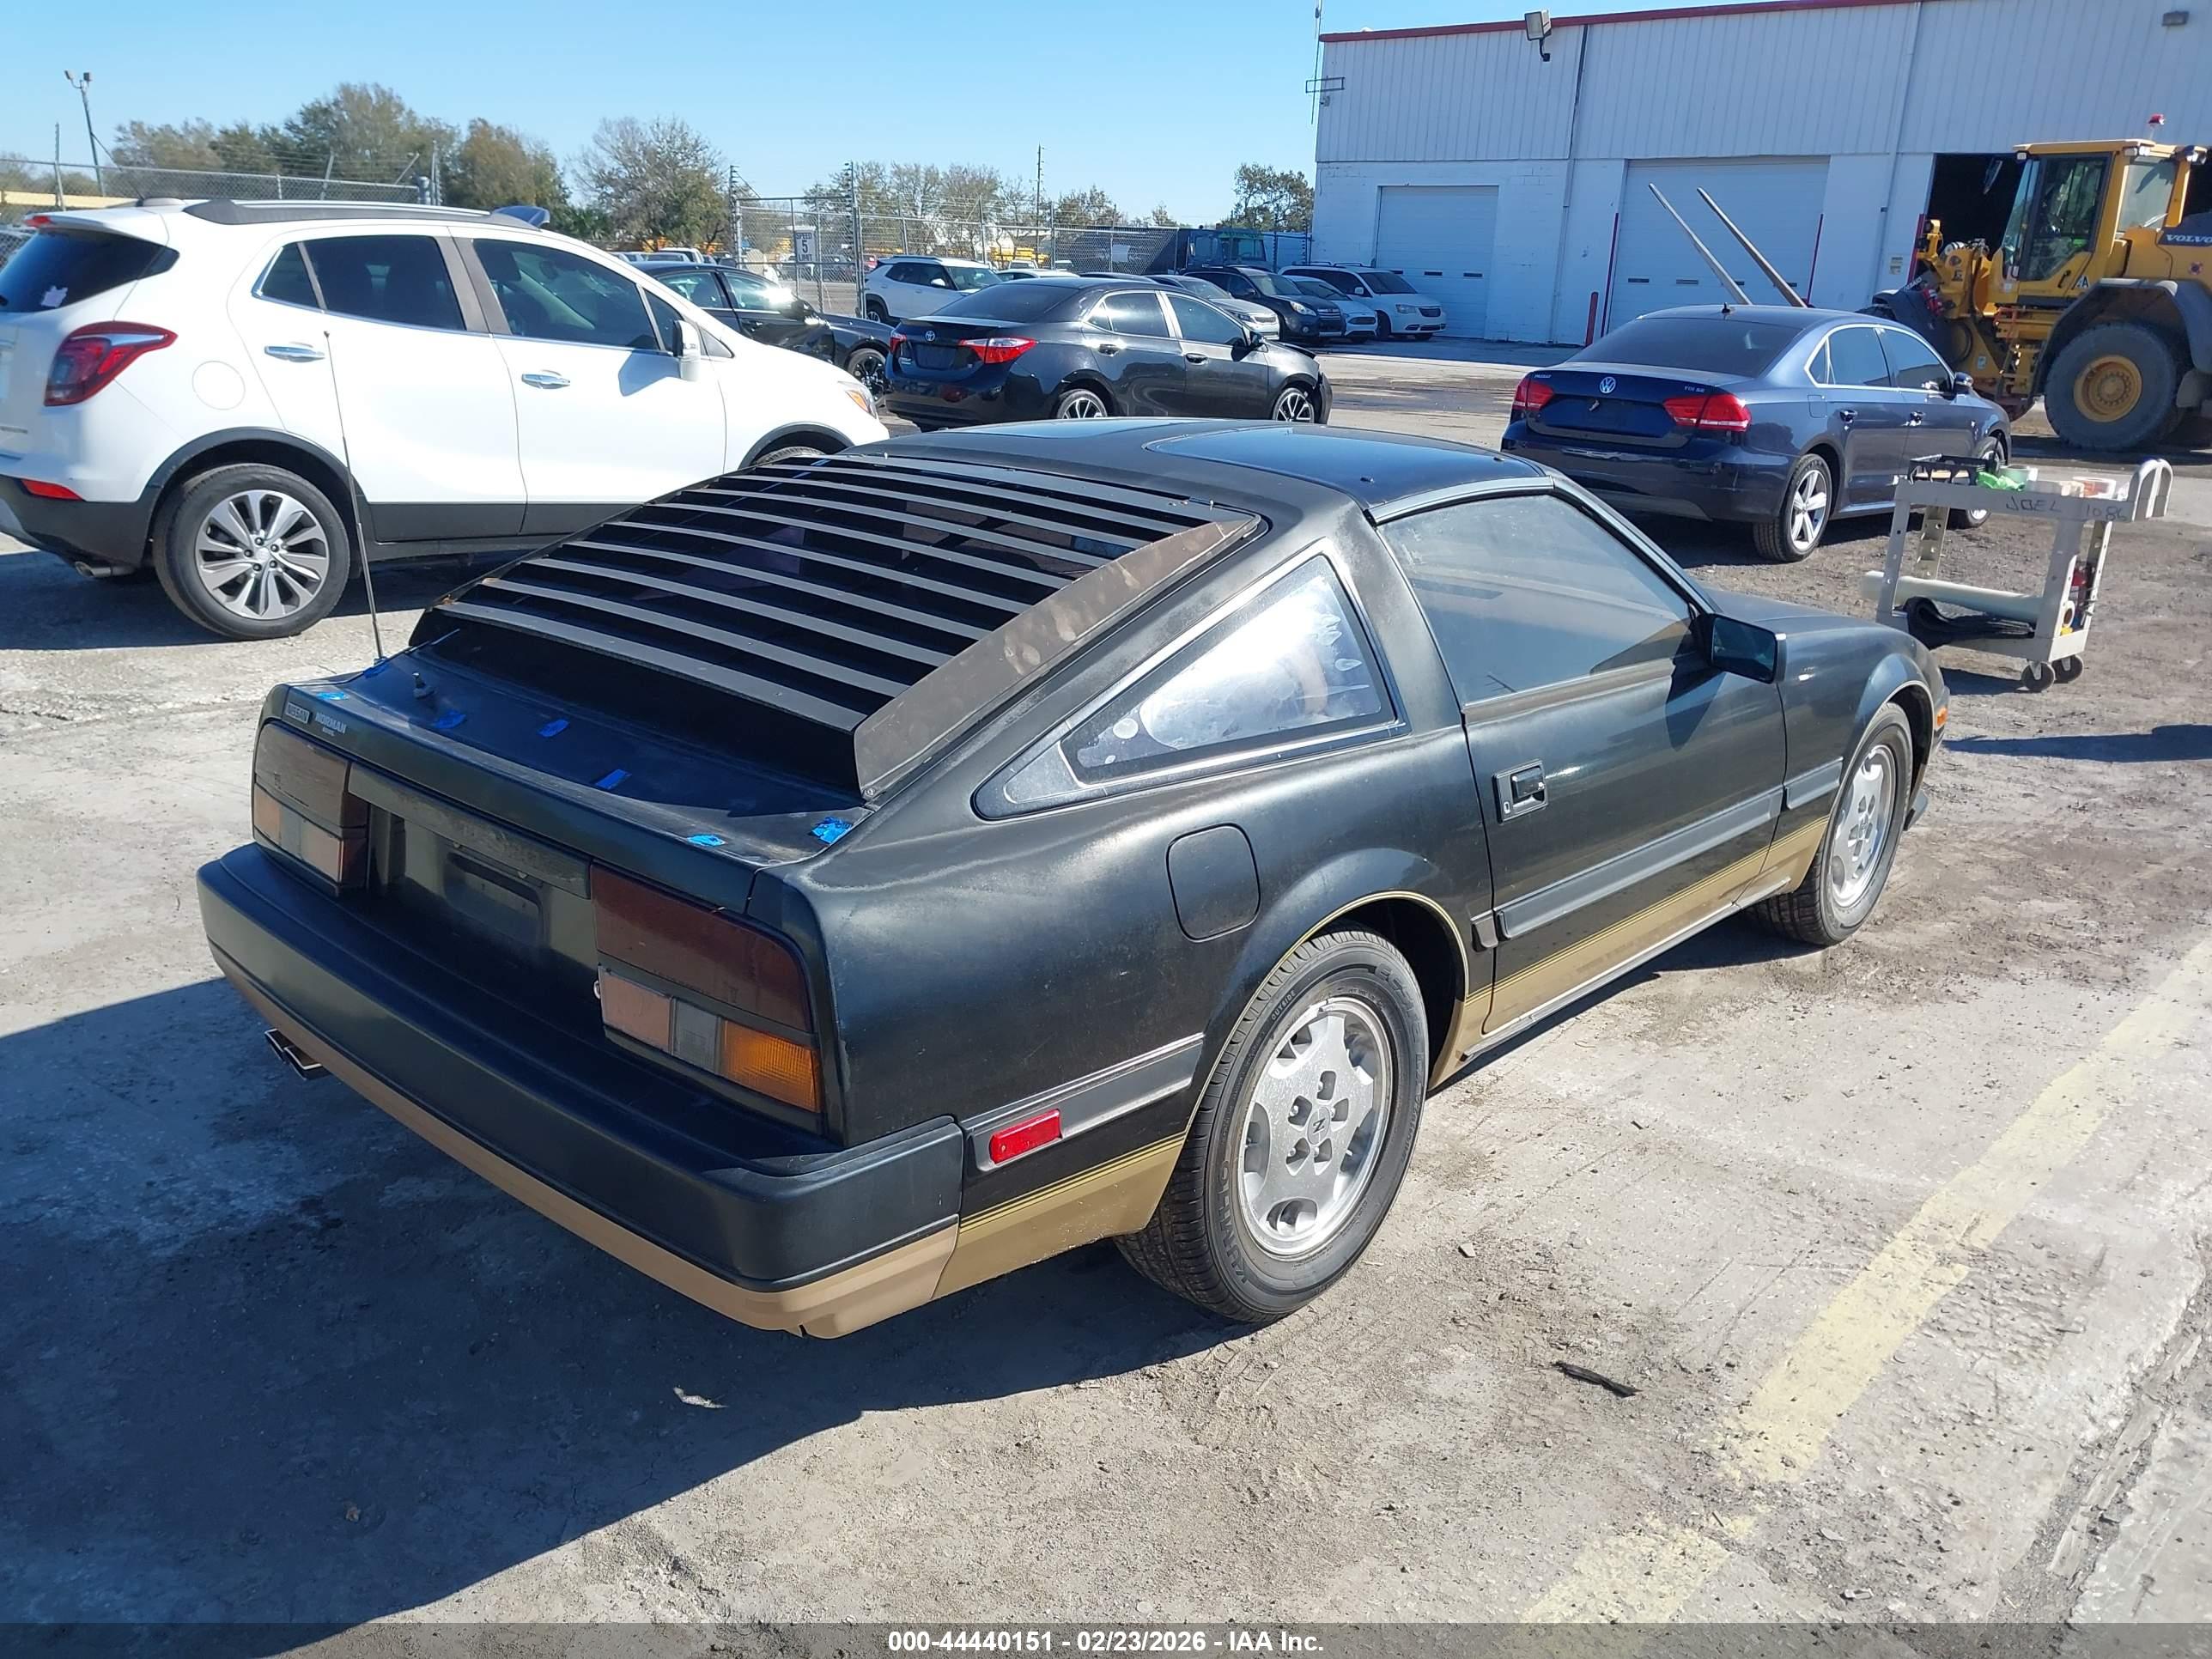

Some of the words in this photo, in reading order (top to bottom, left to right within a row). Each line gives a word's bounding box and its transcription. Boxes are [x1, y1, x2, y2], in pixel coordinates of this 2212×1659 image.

[2166, 234, 2212, 243] VOLVO
[801, 240, 808, 253] 5
[798, 253, 812, 262] LIMIT
[2006, 495, 2061, 513] JOEL
[1271, 989, 1297, 1020] OUTSIDE
[1218, 1160, 1248, 1285] KUMHO
